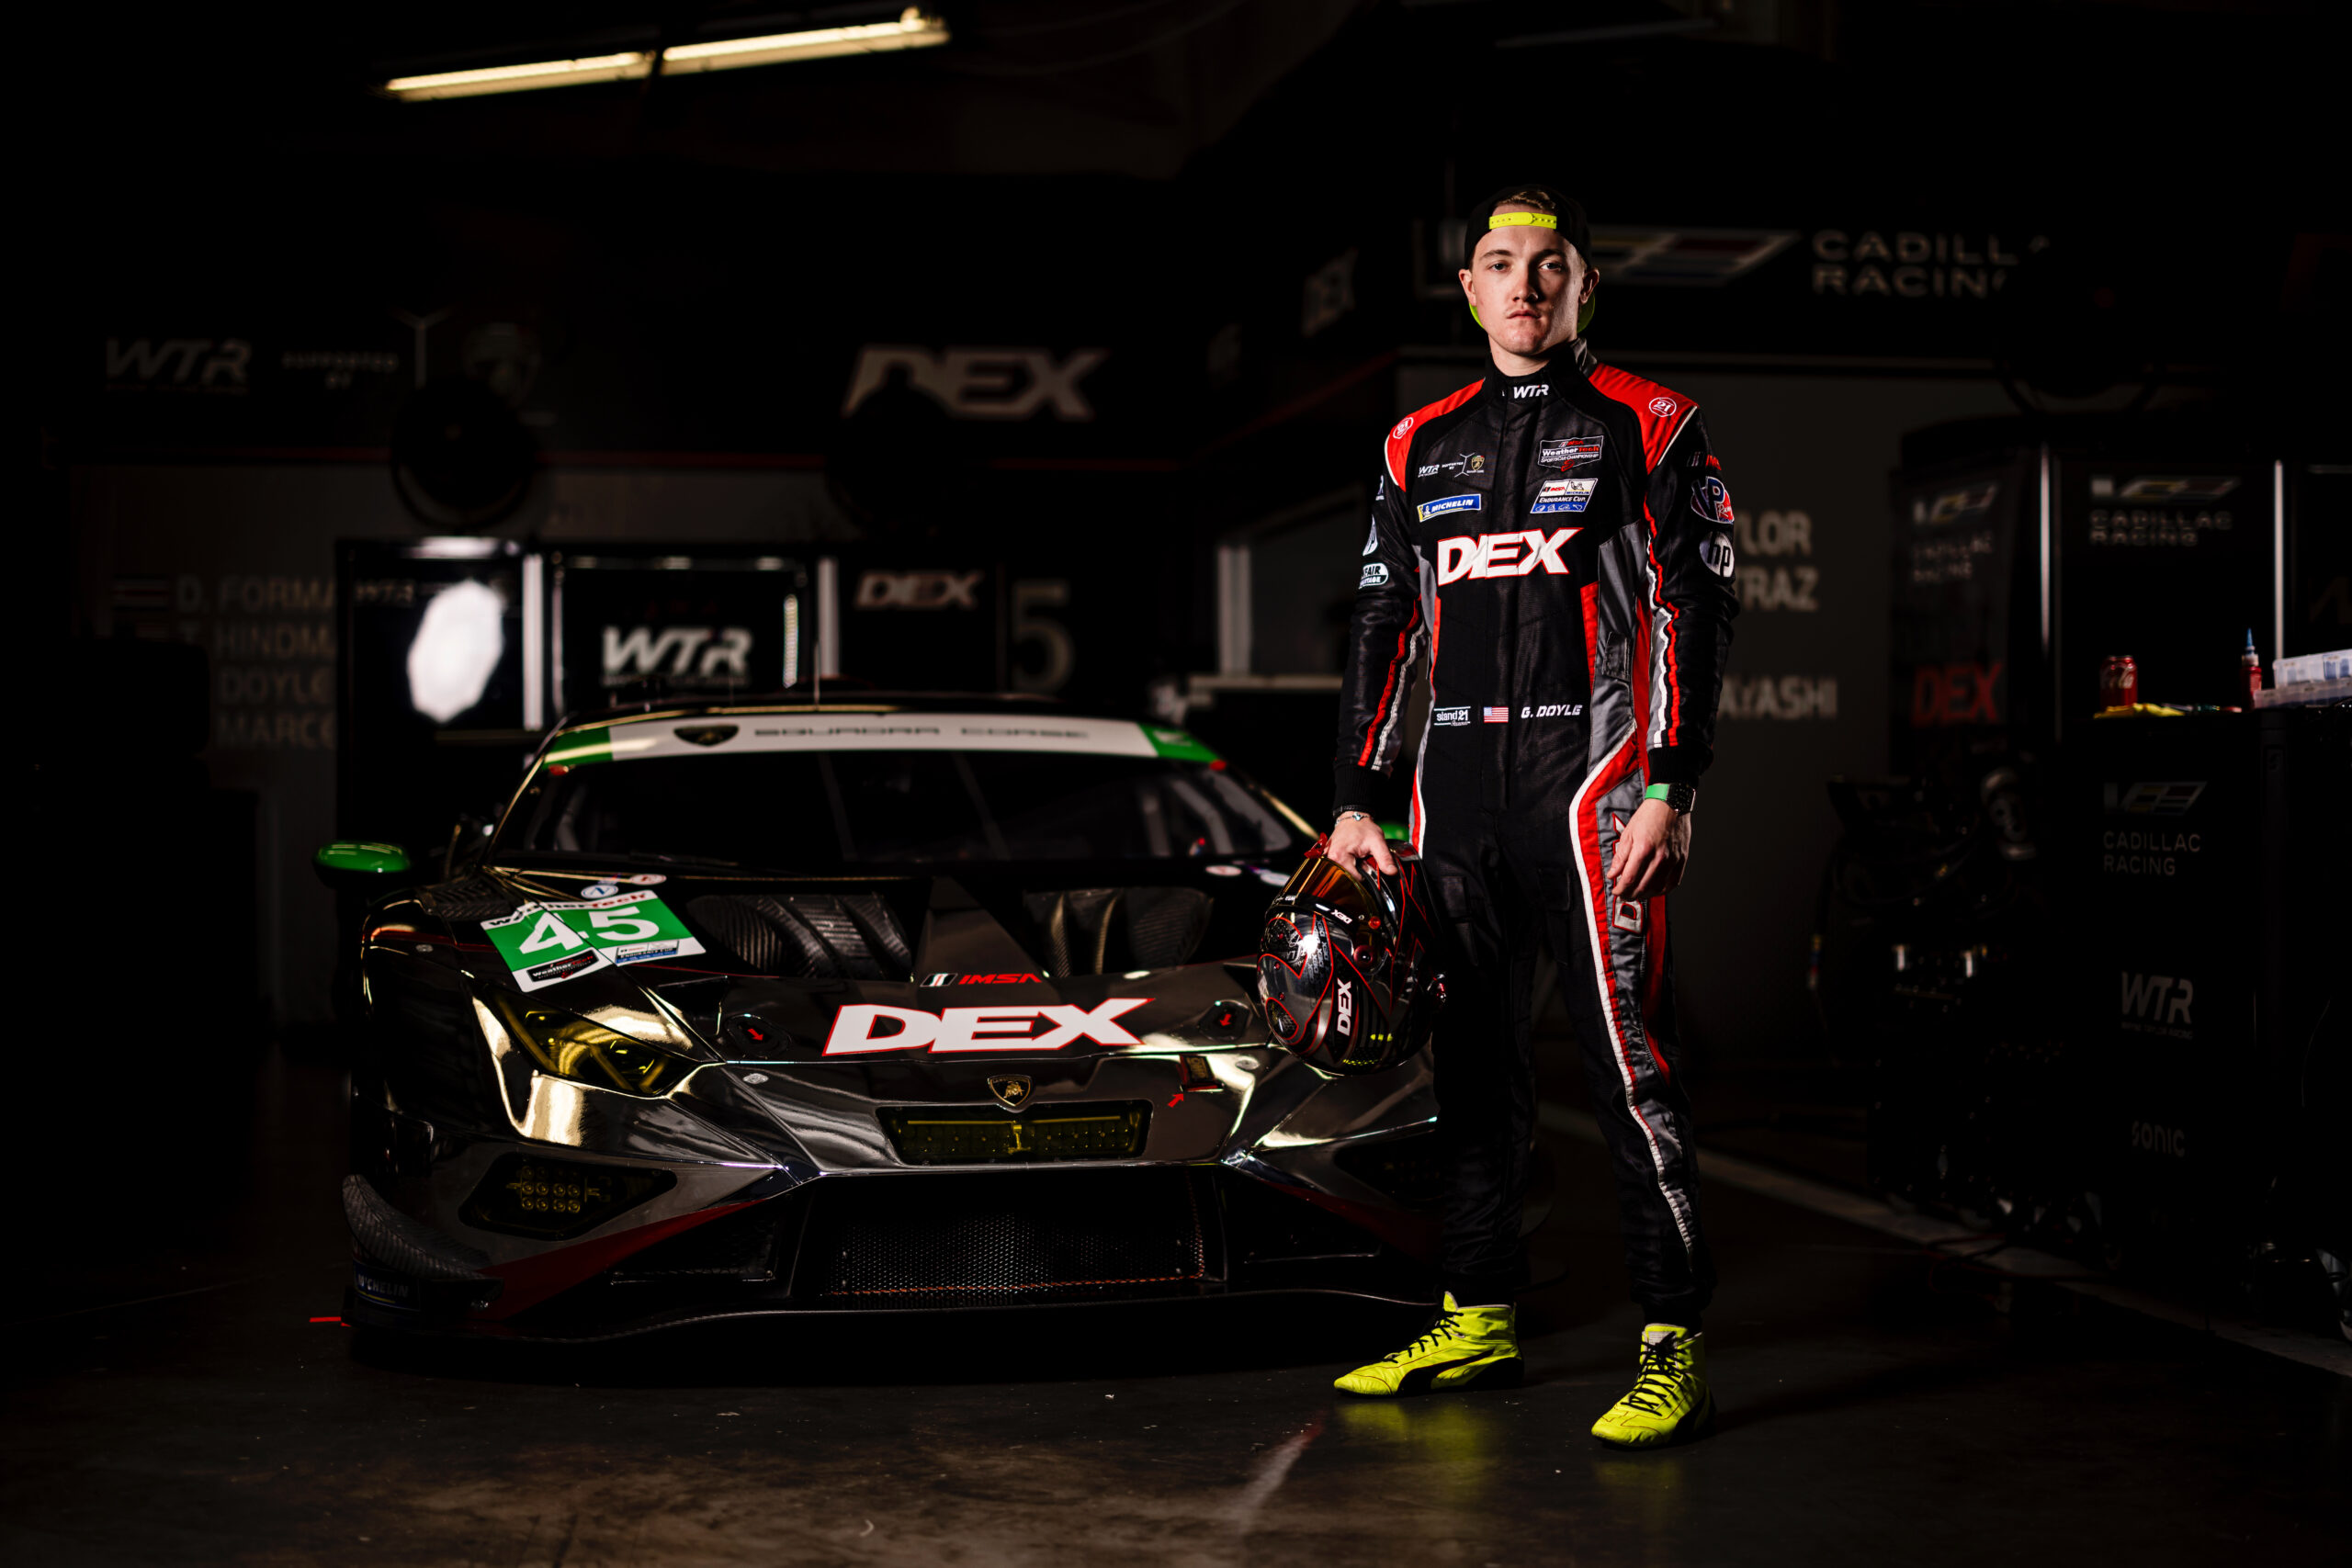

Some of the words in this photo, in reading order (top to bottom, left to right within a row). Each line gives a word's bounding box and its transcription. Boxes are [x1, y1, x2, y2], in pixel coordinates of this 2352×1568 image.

[106, 338, 252, 385] WTR
[1513, 383, 1549, 399] WTR
[1653, 400, 1672, 413] 21
[1419, 464, 1440, 474] WTR
[1431, 499, 1475, 513] MICHELIN
[2090, 509, 2233, 530] CADILLAC
[1733, 509, 1813, 557] LOR
[2089, 530, 2198, 547] RACING
[1437, 526, 1585, 587] DEX
[851, 569, 985, 613] DEX
[602, 626, 753, 677] WTR
[1912, 663, 2001, 727] DEX
[1521, 706, 1533, 719] G.
[1536, 705, 1583, 717] DOYLE
[2103, 830, 2201, 852] CADILLAC
[2103, 853, 2176, 876] RACING
[519, 906, 660, 954] 45
[958, 973, 1042, 985] IMSA
[1337, 977, 1352, 1036] DEX
[2120, 970, 2194, 1024] WTR
[823, 998, 1155, 1055] DEX
[358, 1273, 409, 1298] MICHELIN
